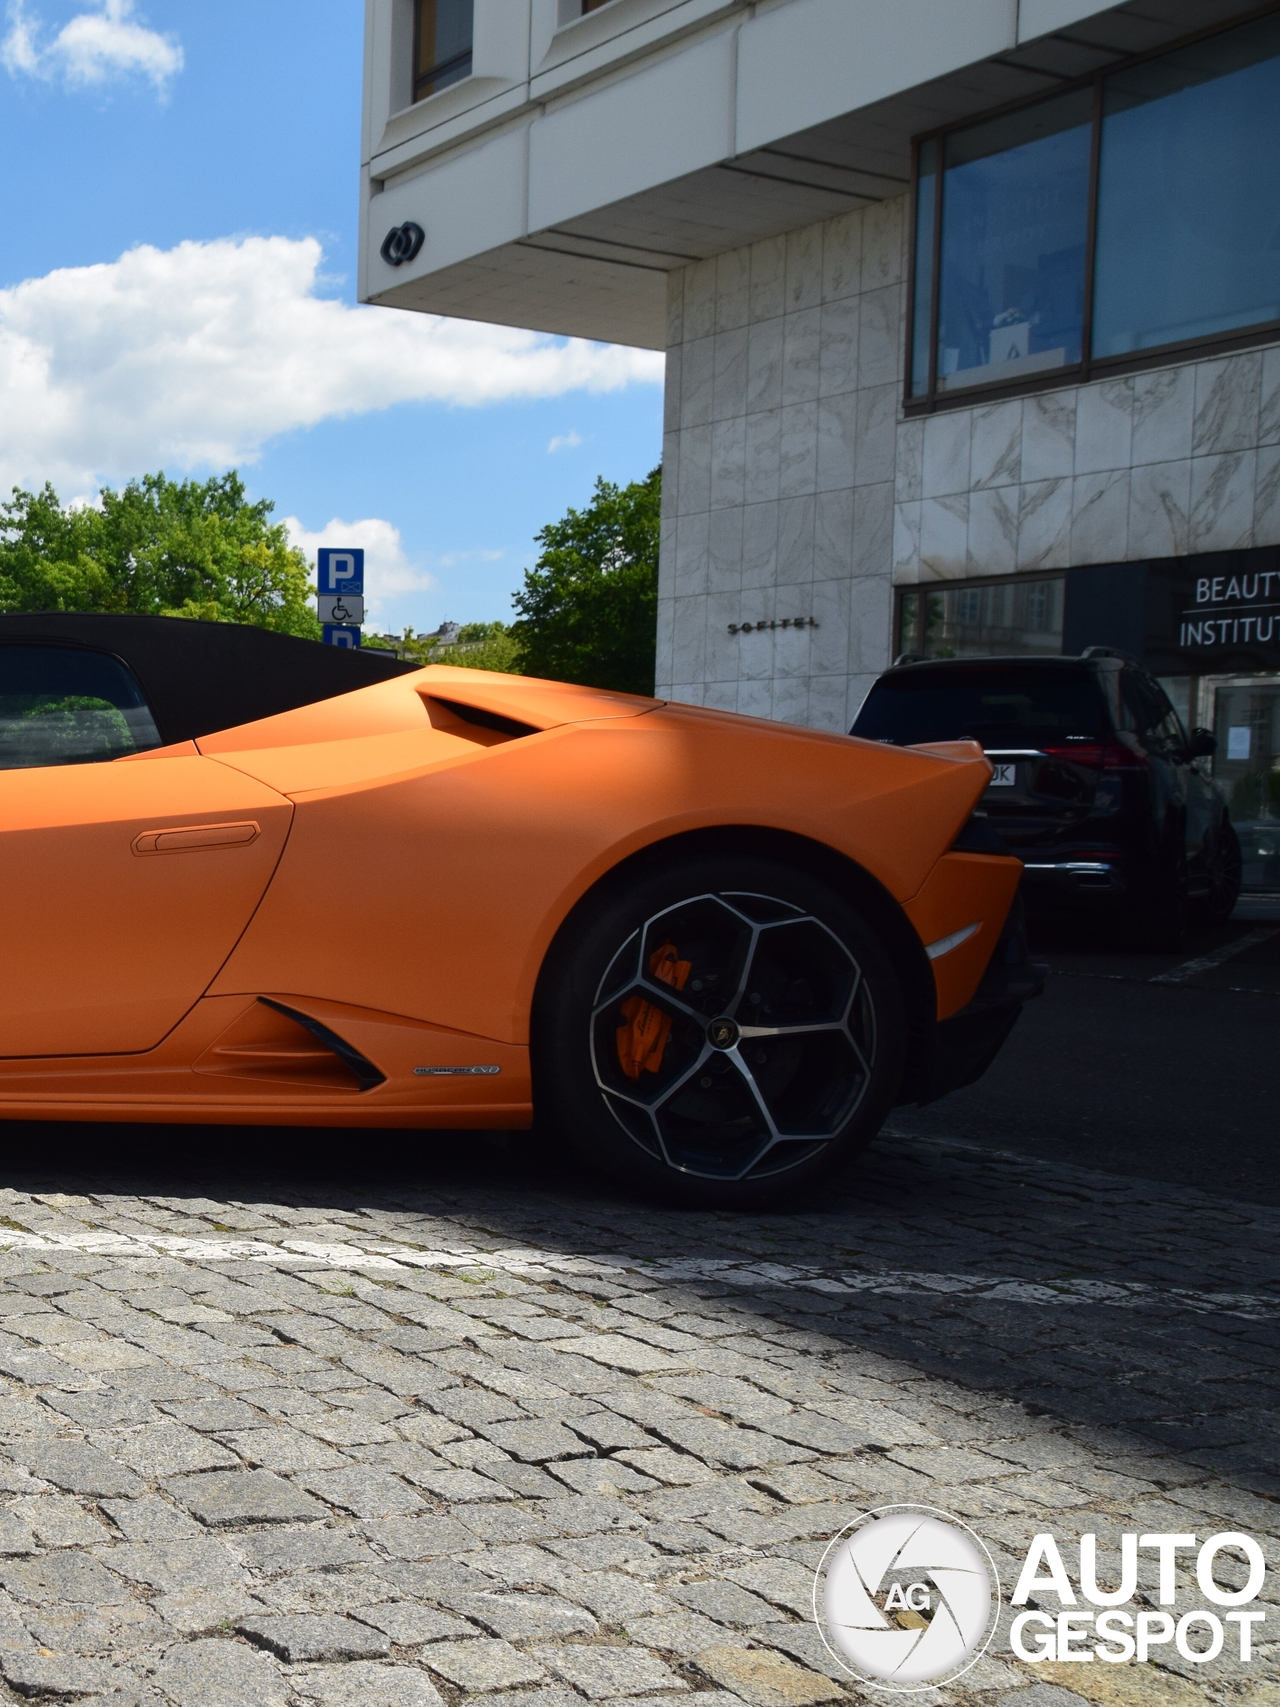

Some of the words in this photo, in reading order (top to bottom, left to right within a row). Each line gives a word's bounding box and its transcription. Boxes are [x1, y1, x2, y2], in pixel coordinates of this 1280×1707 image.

[329, 553, 355, 589] P
[1196, 571, 1280, 603] BEAUT
[727, 615, 820, 635] SOFITEL
